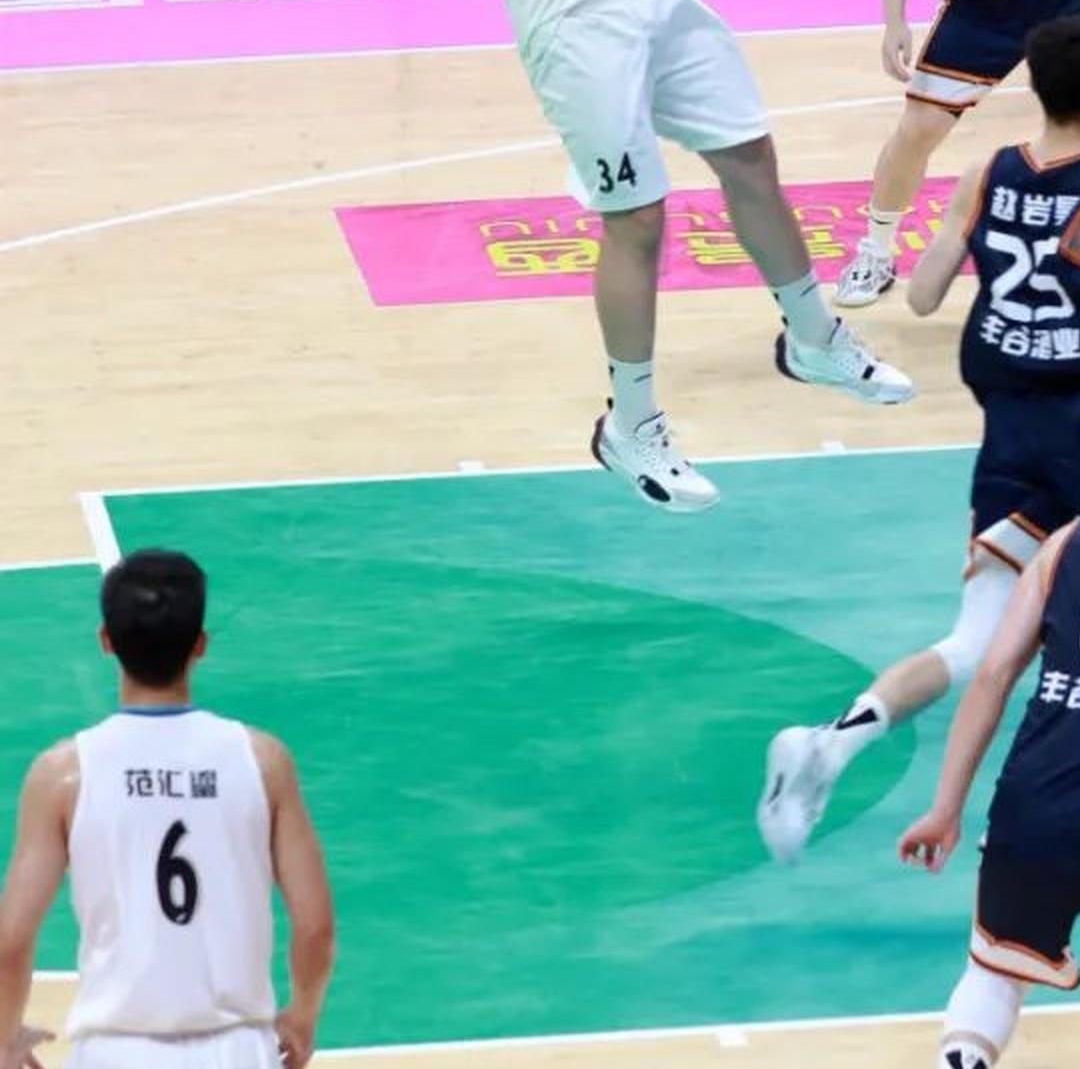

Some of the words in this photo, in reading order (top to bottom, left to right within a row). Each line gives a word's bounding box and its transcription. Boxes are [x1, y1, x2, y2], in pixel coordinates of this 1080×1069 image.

[596, 151, 637, 194] 34
[985, 229, 1076, 323] 25
[155, 818, 199, 927] 6
